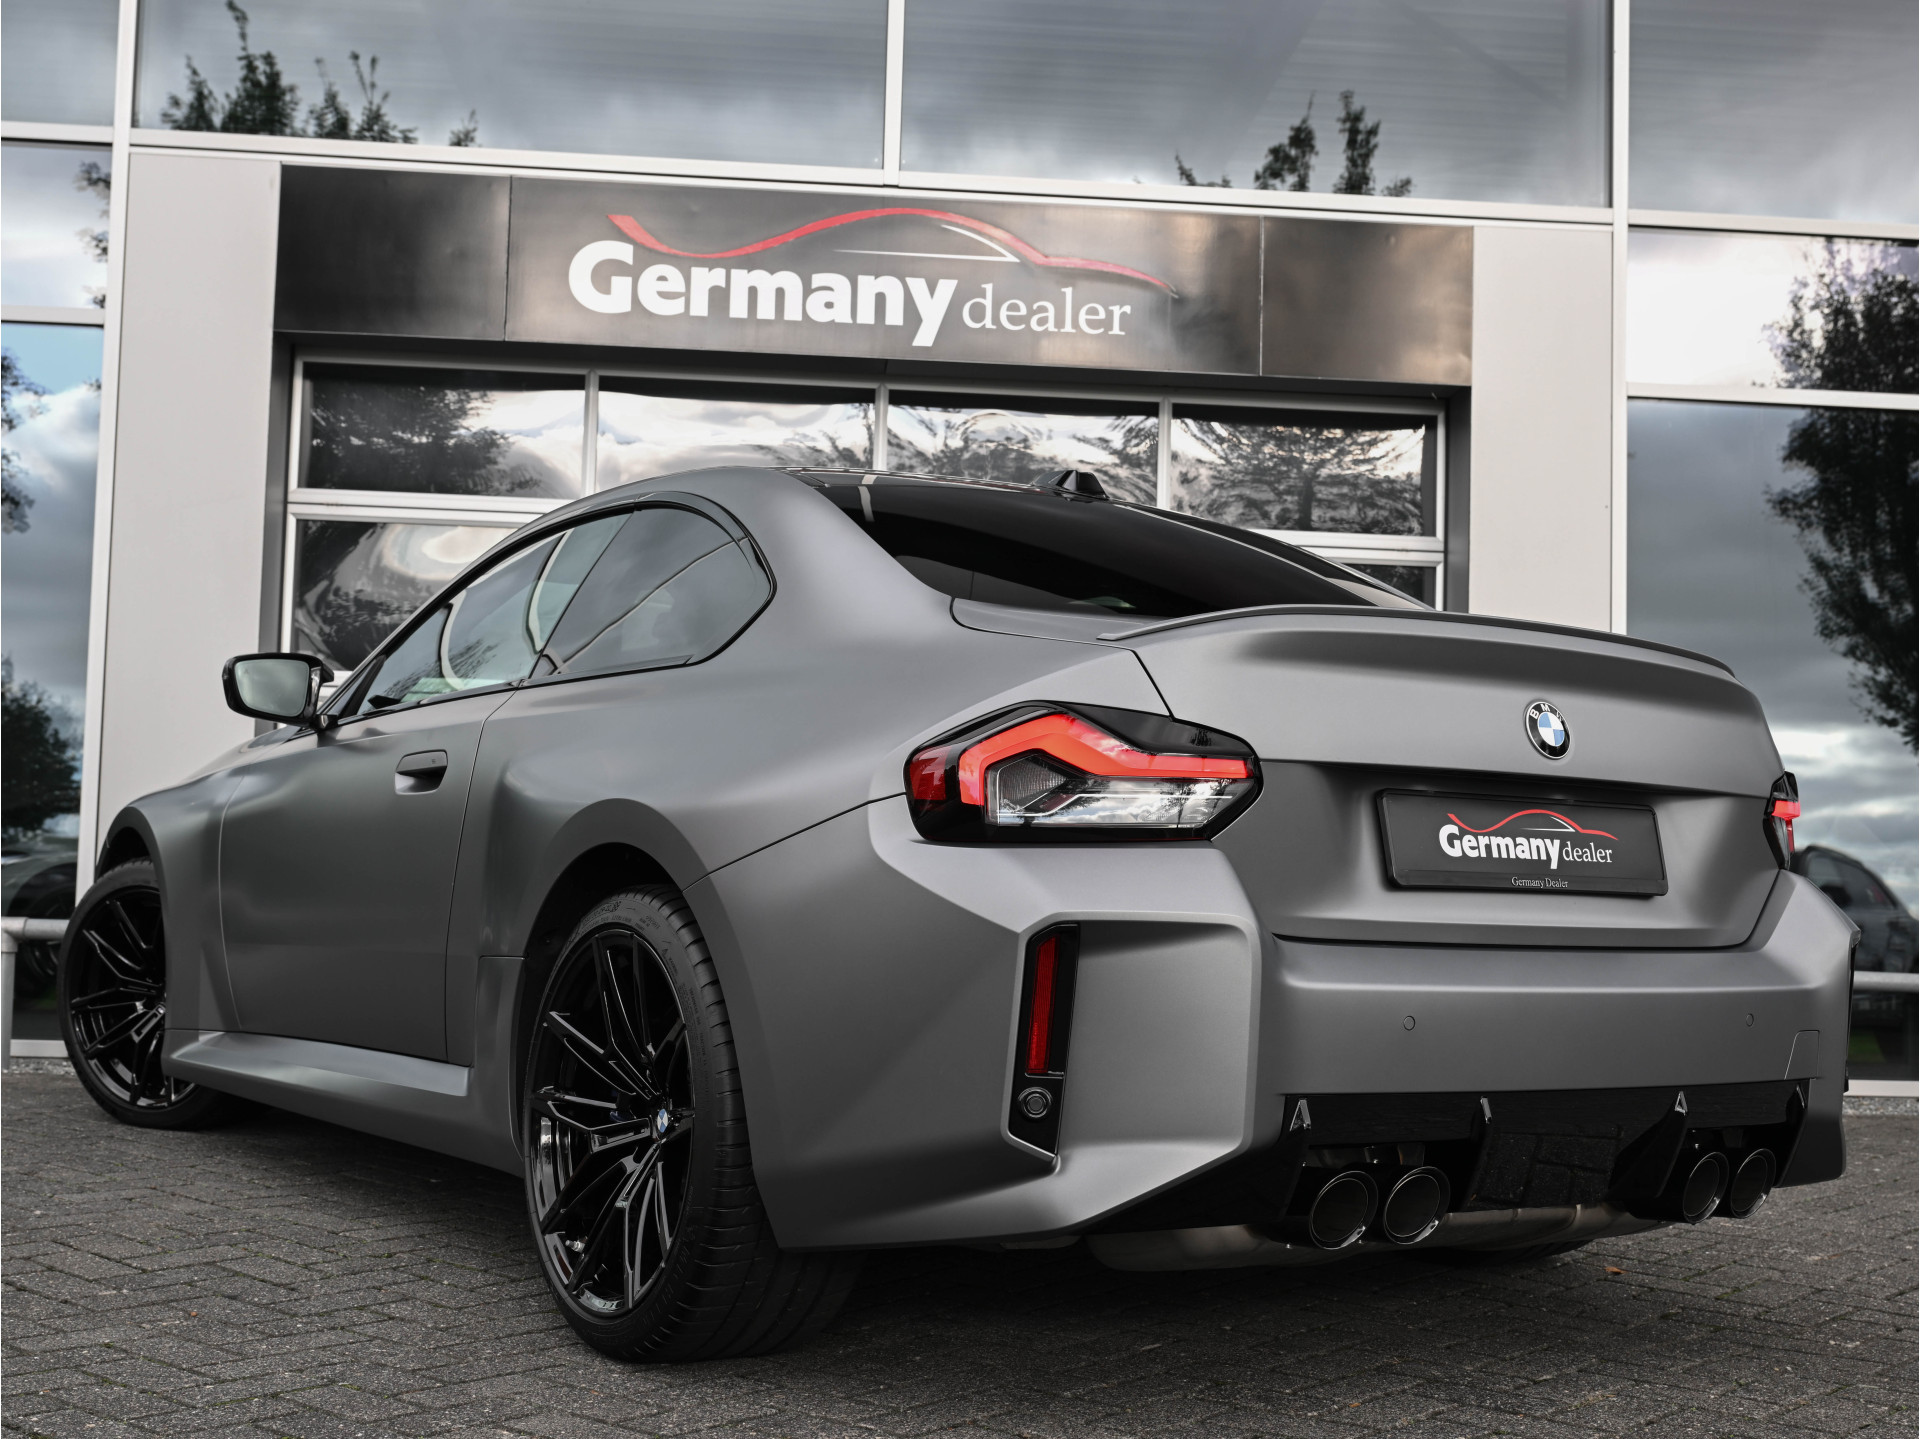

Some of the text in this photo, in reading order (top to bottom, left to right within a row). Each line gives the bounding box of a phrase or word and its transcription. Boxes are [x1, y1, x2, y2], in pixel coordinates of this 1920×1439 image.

[568, 240, 1132, 347] Germany dealer
[1529, 703, 1564, 722] BMW
[1438, 823, 1613, 870] Germany dealer
[1511, 876, 1569, 889] Germany Dealer
